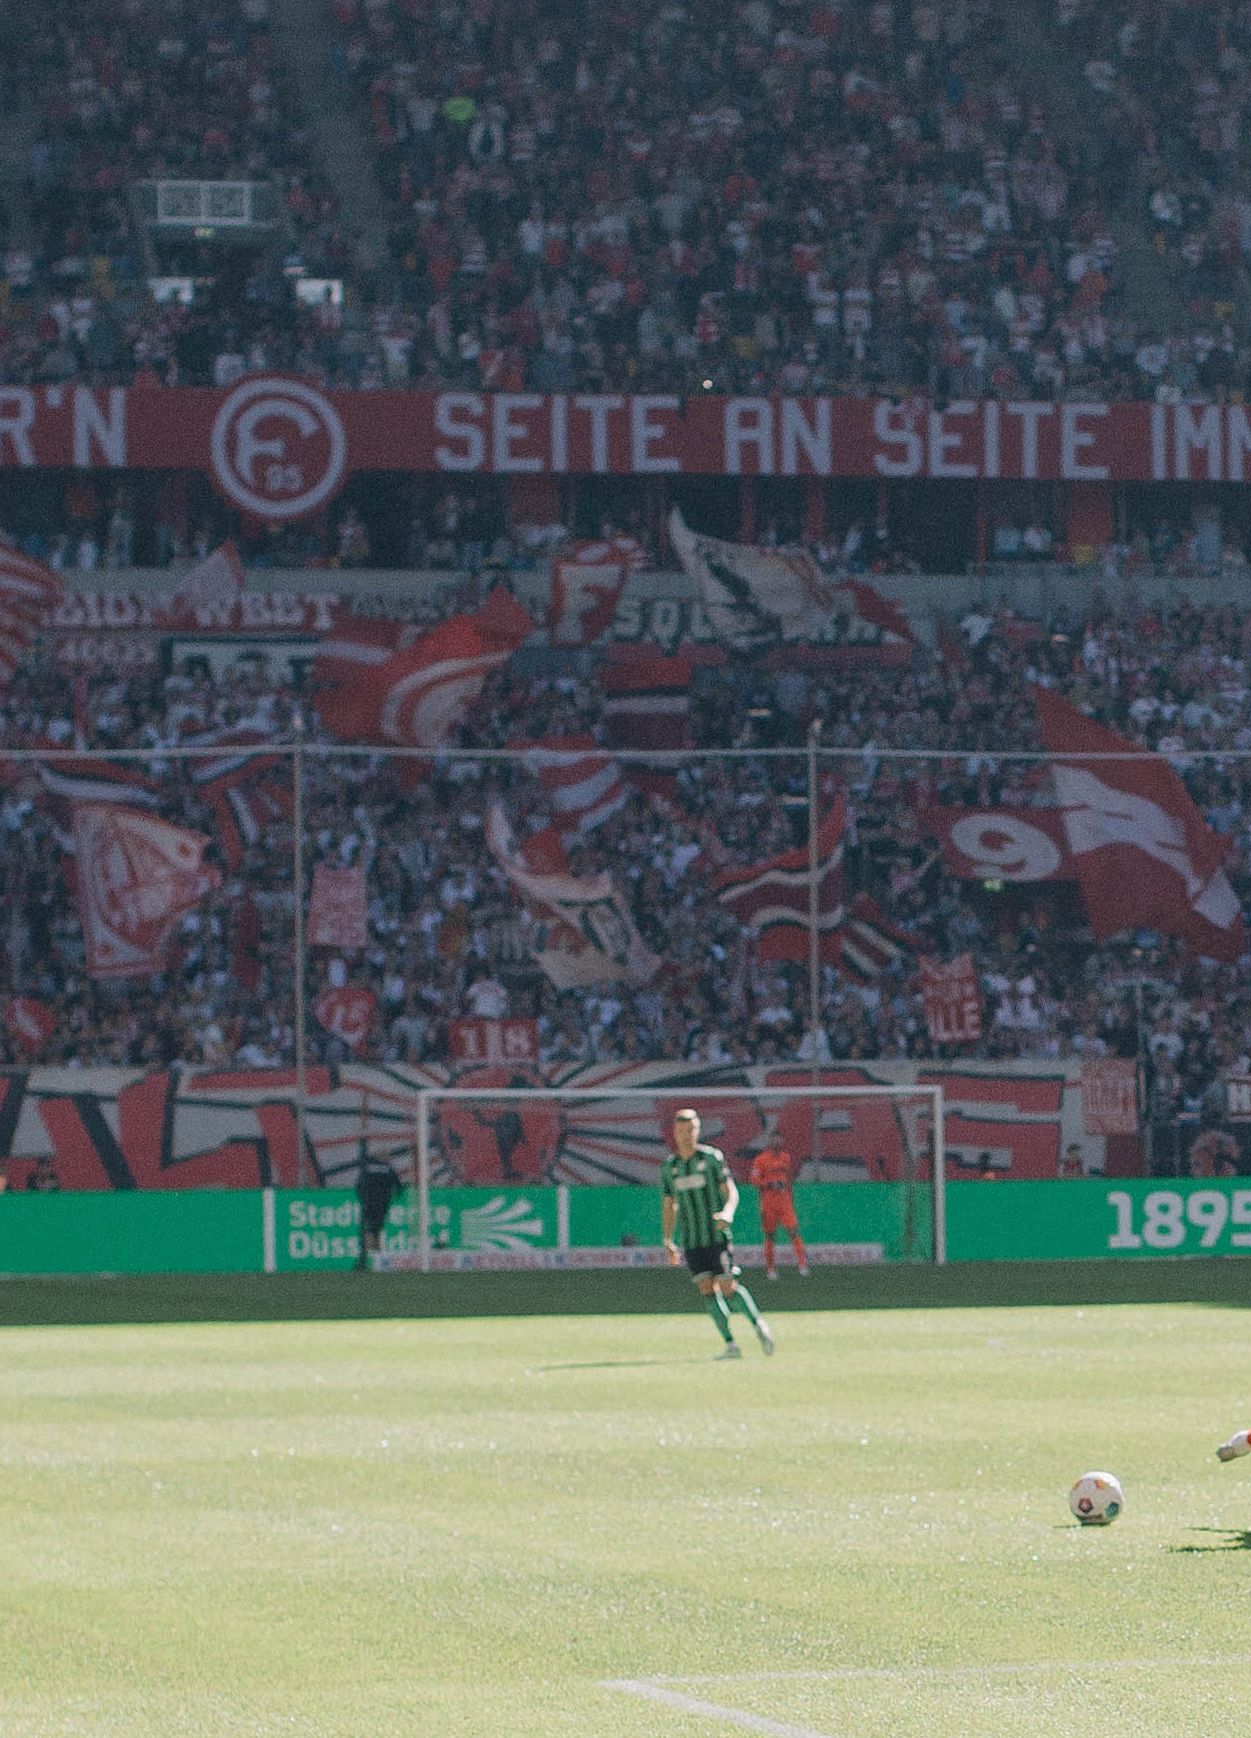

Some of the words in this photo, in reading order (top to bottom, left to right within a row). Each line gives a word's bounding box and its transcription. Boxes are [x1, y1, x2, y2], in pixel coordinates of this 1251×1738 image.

[434, 393, 681, 473] SEITE
[724, 397, 832, 474] AN
[874, 400, 1108, 478] SEITE
